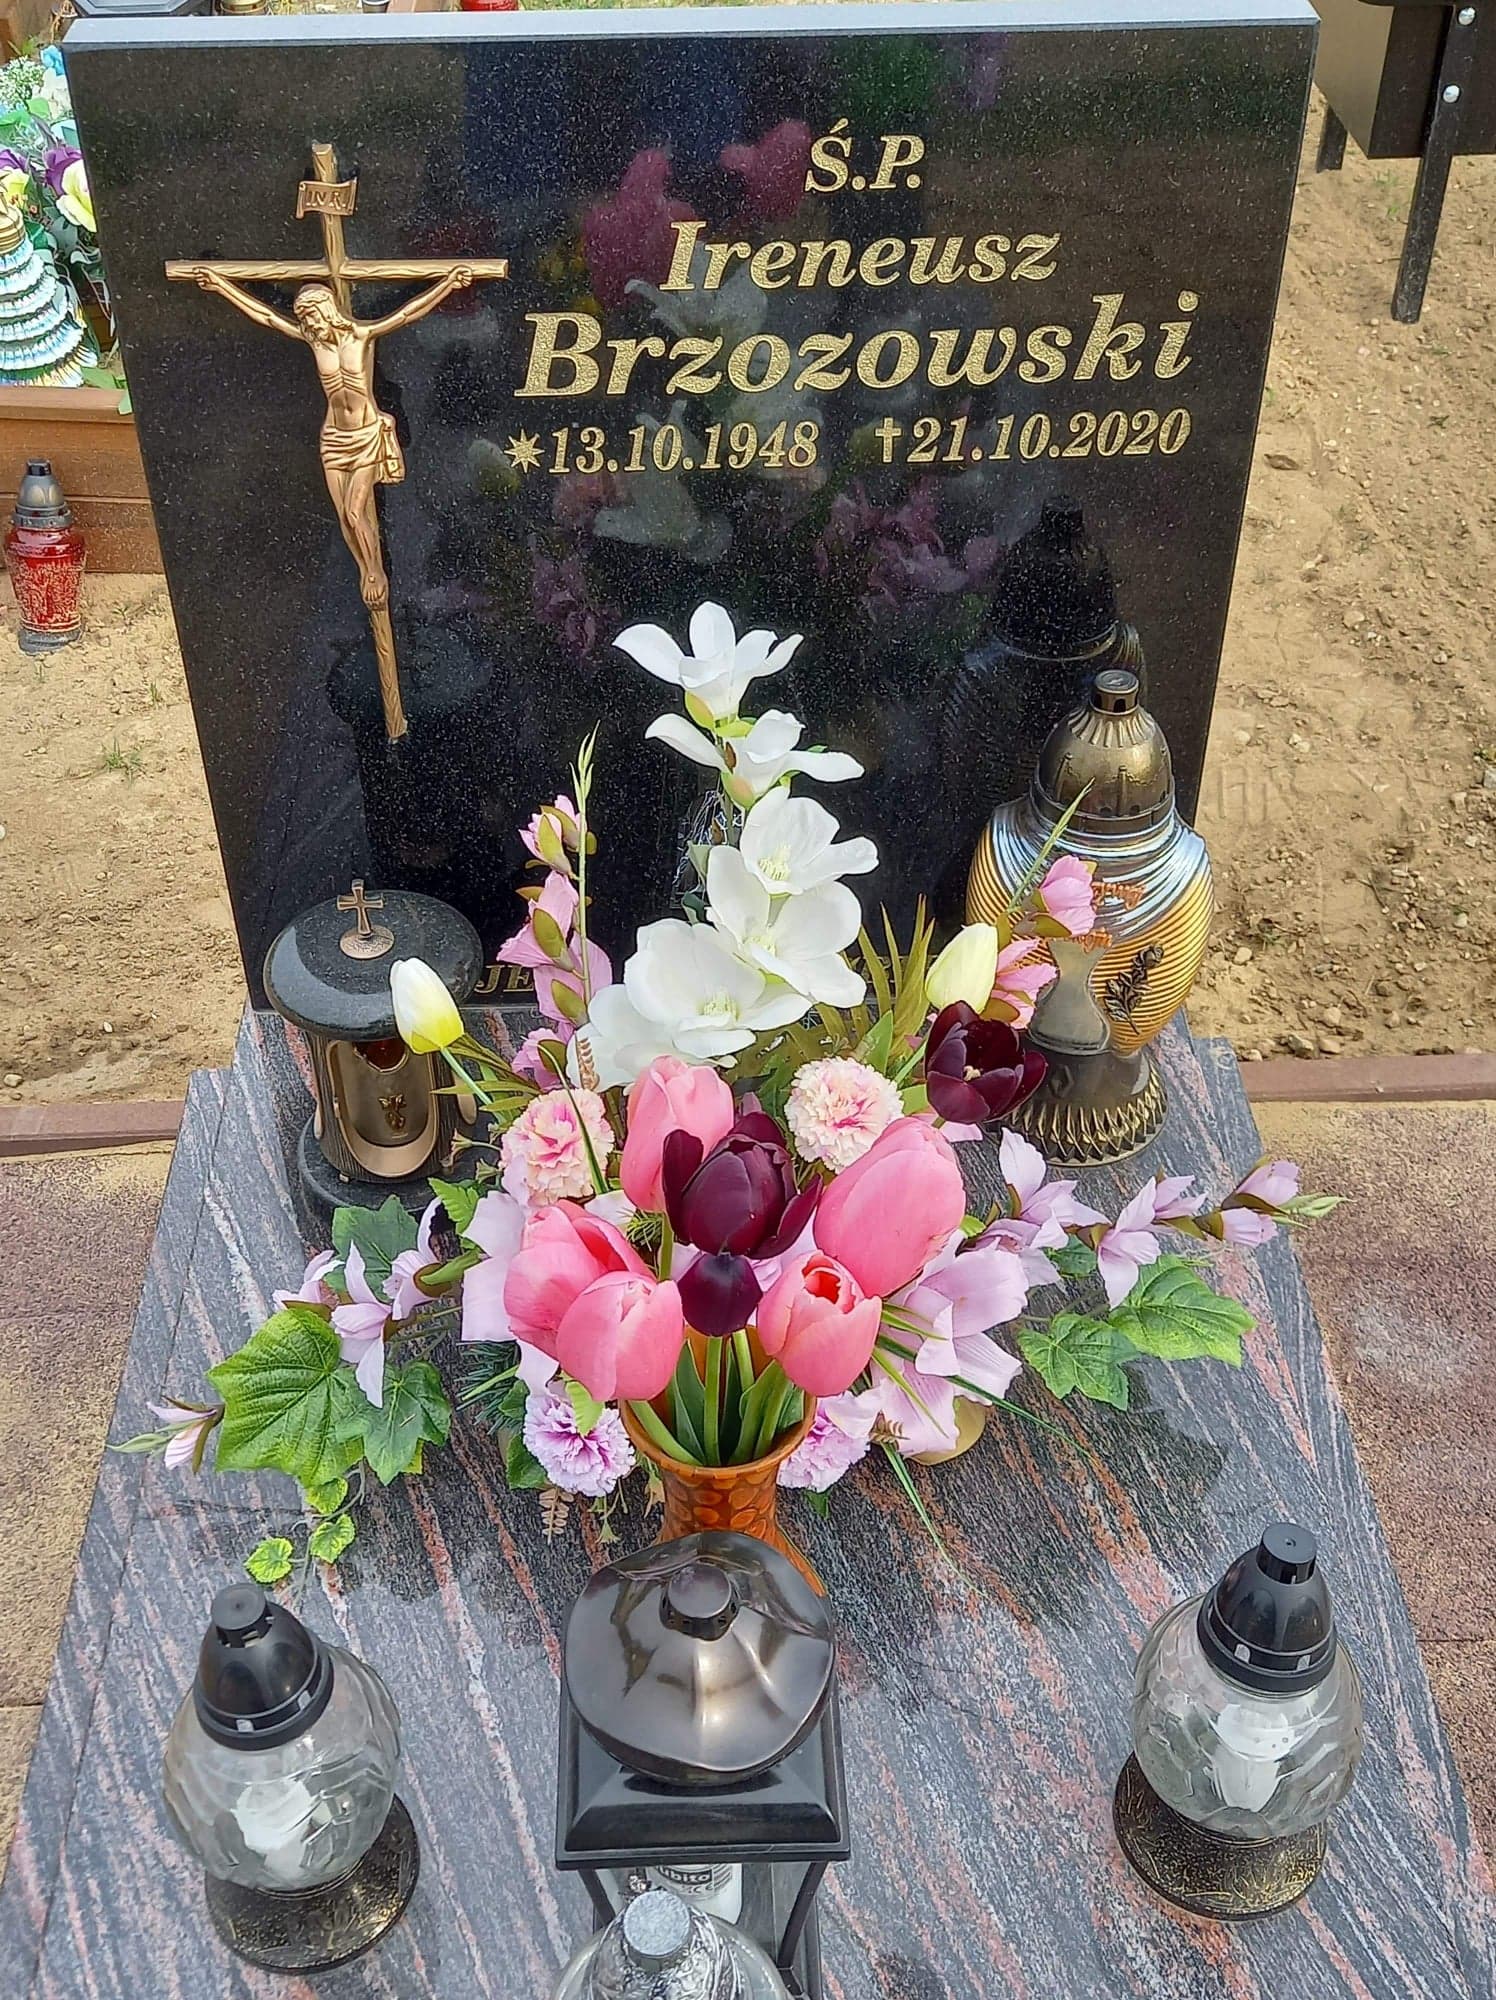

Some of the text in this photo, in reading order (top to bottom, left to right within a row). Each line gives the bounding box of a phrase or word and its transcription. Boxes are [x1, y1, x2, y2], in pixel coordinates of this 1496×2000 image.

[804, 118, 925, 193] Ś.P.
[659, 220, 1061, 291] Ireneusz
[514, 290, 1199, 397] Brzozowski
